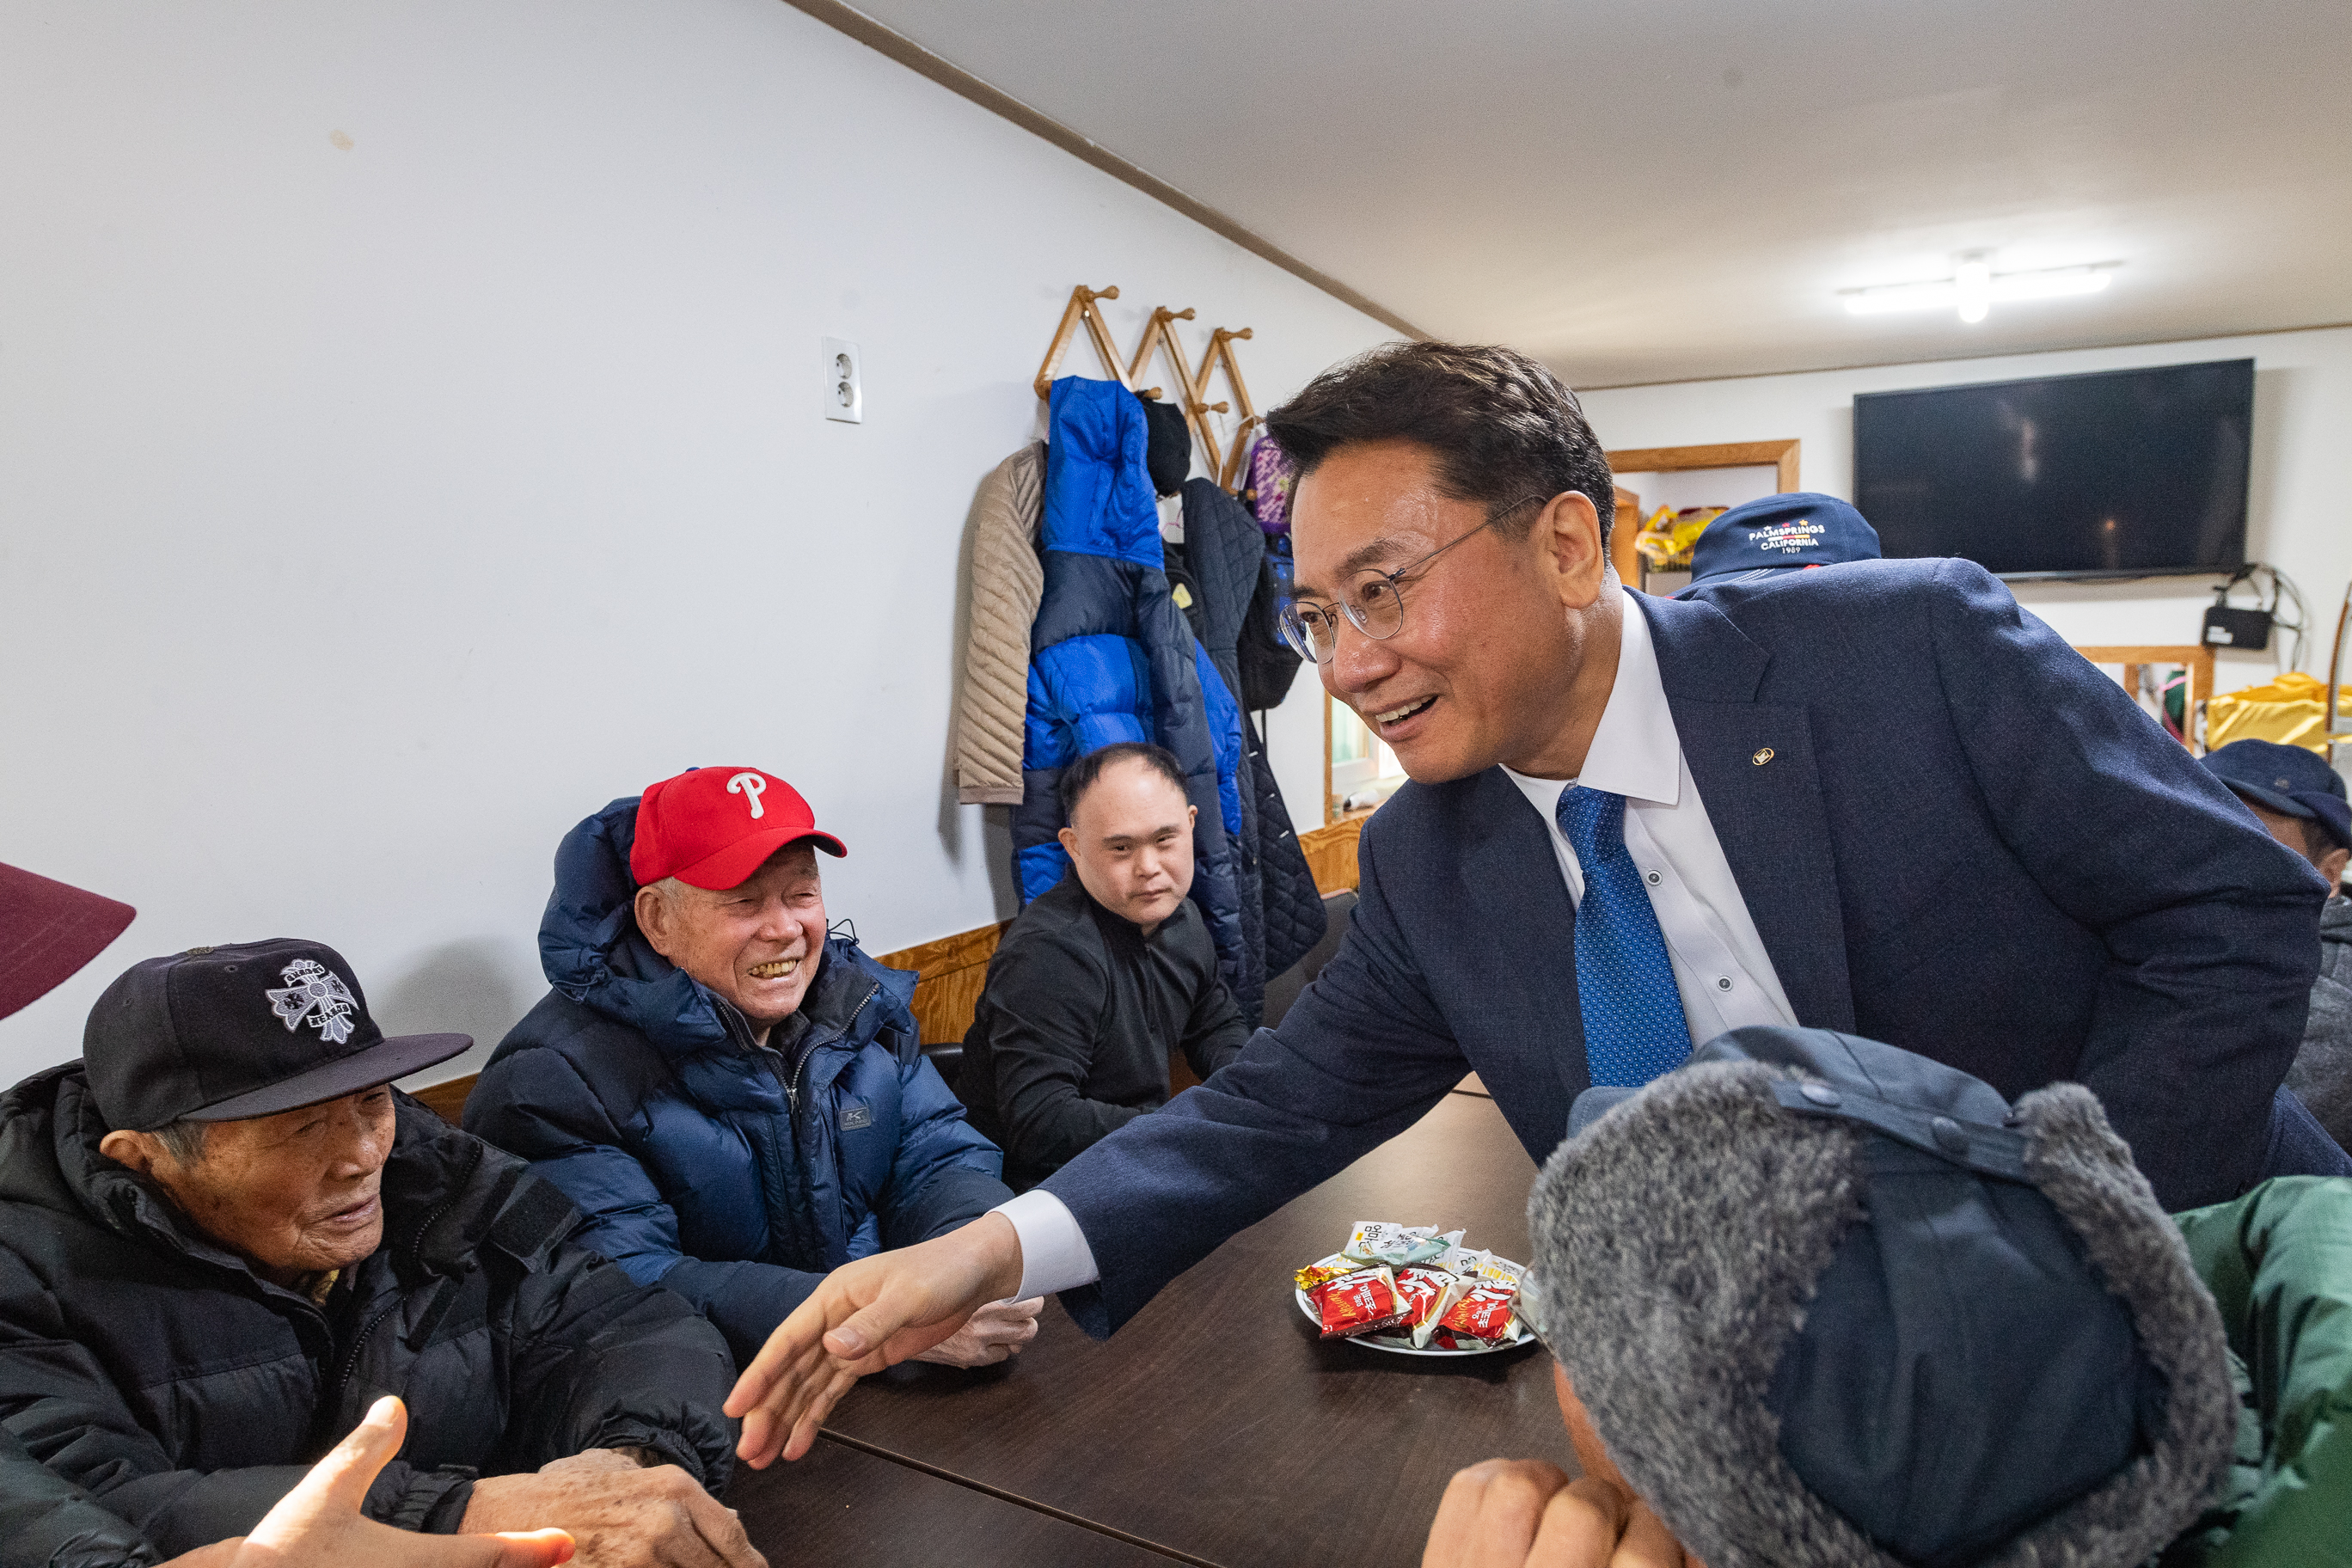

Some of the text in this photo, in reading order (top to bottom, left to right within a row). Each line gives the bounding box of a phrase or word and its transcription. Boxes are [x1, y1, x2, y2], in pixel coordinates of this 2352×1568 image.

[1749, 524, 1825, 541] PALMSPRINGS
[1761, 538, 1819, 551] CALIFORNIA
[726, 772, 767, 819] P
[1358, 1224, 1382, 1248] 엄마
